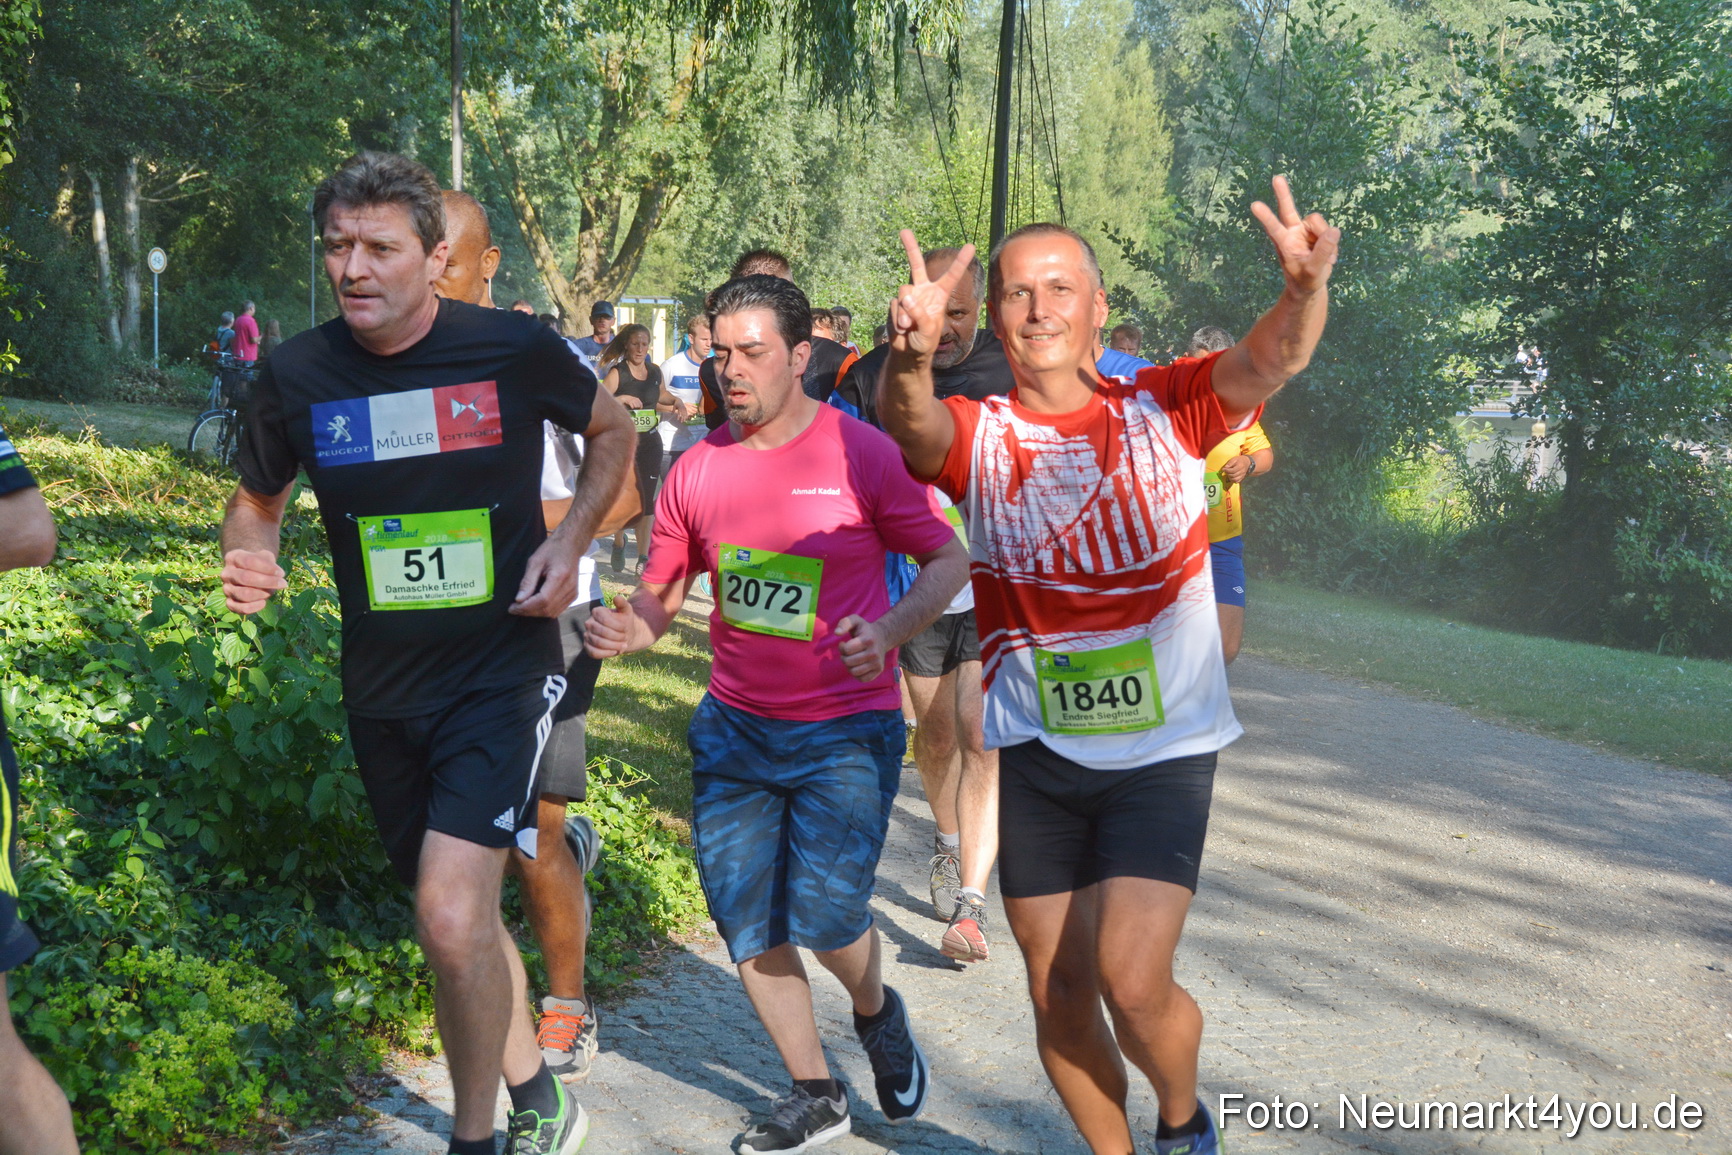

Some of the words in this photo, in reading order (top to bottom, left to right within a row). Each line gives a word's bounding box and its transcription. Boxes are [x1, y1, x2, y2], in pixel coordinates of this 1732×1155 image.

[376, 432, 434, 450] MÜLLER
[318, 445, 370, 457] PEUGEOT
[404, 546, 445, 583] 51
[385, 583, 440, 595] Damaschke
[442, 580, 475, 591] Erfried
[393, 593, 423, 601] Autohaus
[446, 590, 468, 598] GmbH
[727, 575, 803, 615] 2072
[1052, 676, 1142, 711] 1840
[1062, 712, 1094, 721] Endres
[1097, 708, 1139, 720] Siegfried
